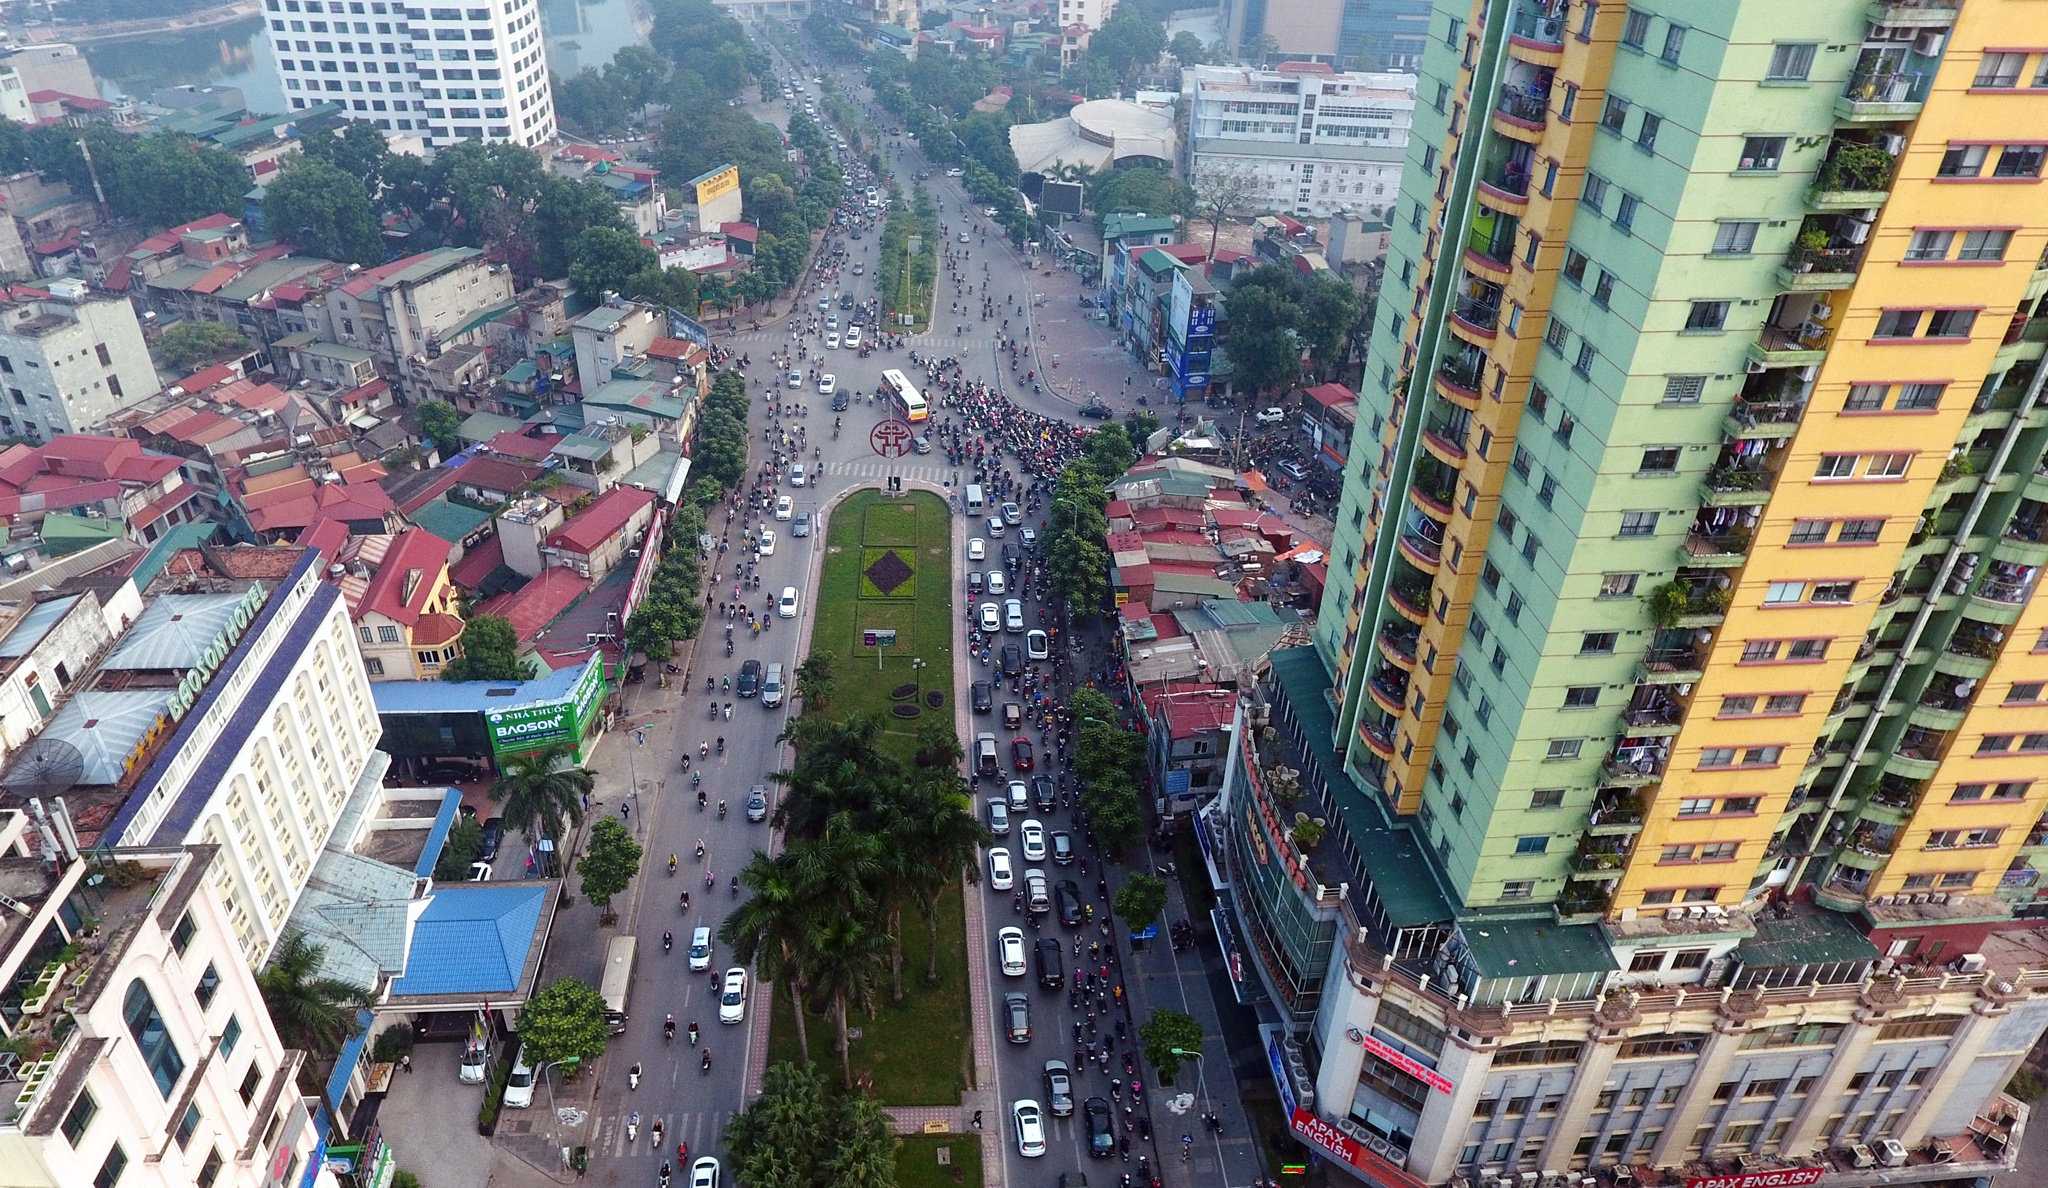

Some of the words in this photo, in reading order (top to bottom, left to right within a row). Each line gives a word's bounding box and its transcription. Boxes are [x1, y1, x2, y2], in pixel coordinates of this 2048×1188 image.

[166, 632, 229, 722] BAOSON
[224, 580, 268, 647] HOTEL
[506, 710, 530, 721] NHÀ
[531, 704, 570, 716] THUỐC
[1363, 1043, 1387, 1058] BUFFET
[1365, 1036, 1380, 1049] NHÀ
[1382, 1045, 1403, 1060] HÀNG
[1426, 1070, 1453, 1088] DZUNG
[1295, 1120, 1353, 1162] ENGLISH
[1308, 1118, 1345, 1146] APAX
[1741, 1171, 1819, 1188] ENGLISH
